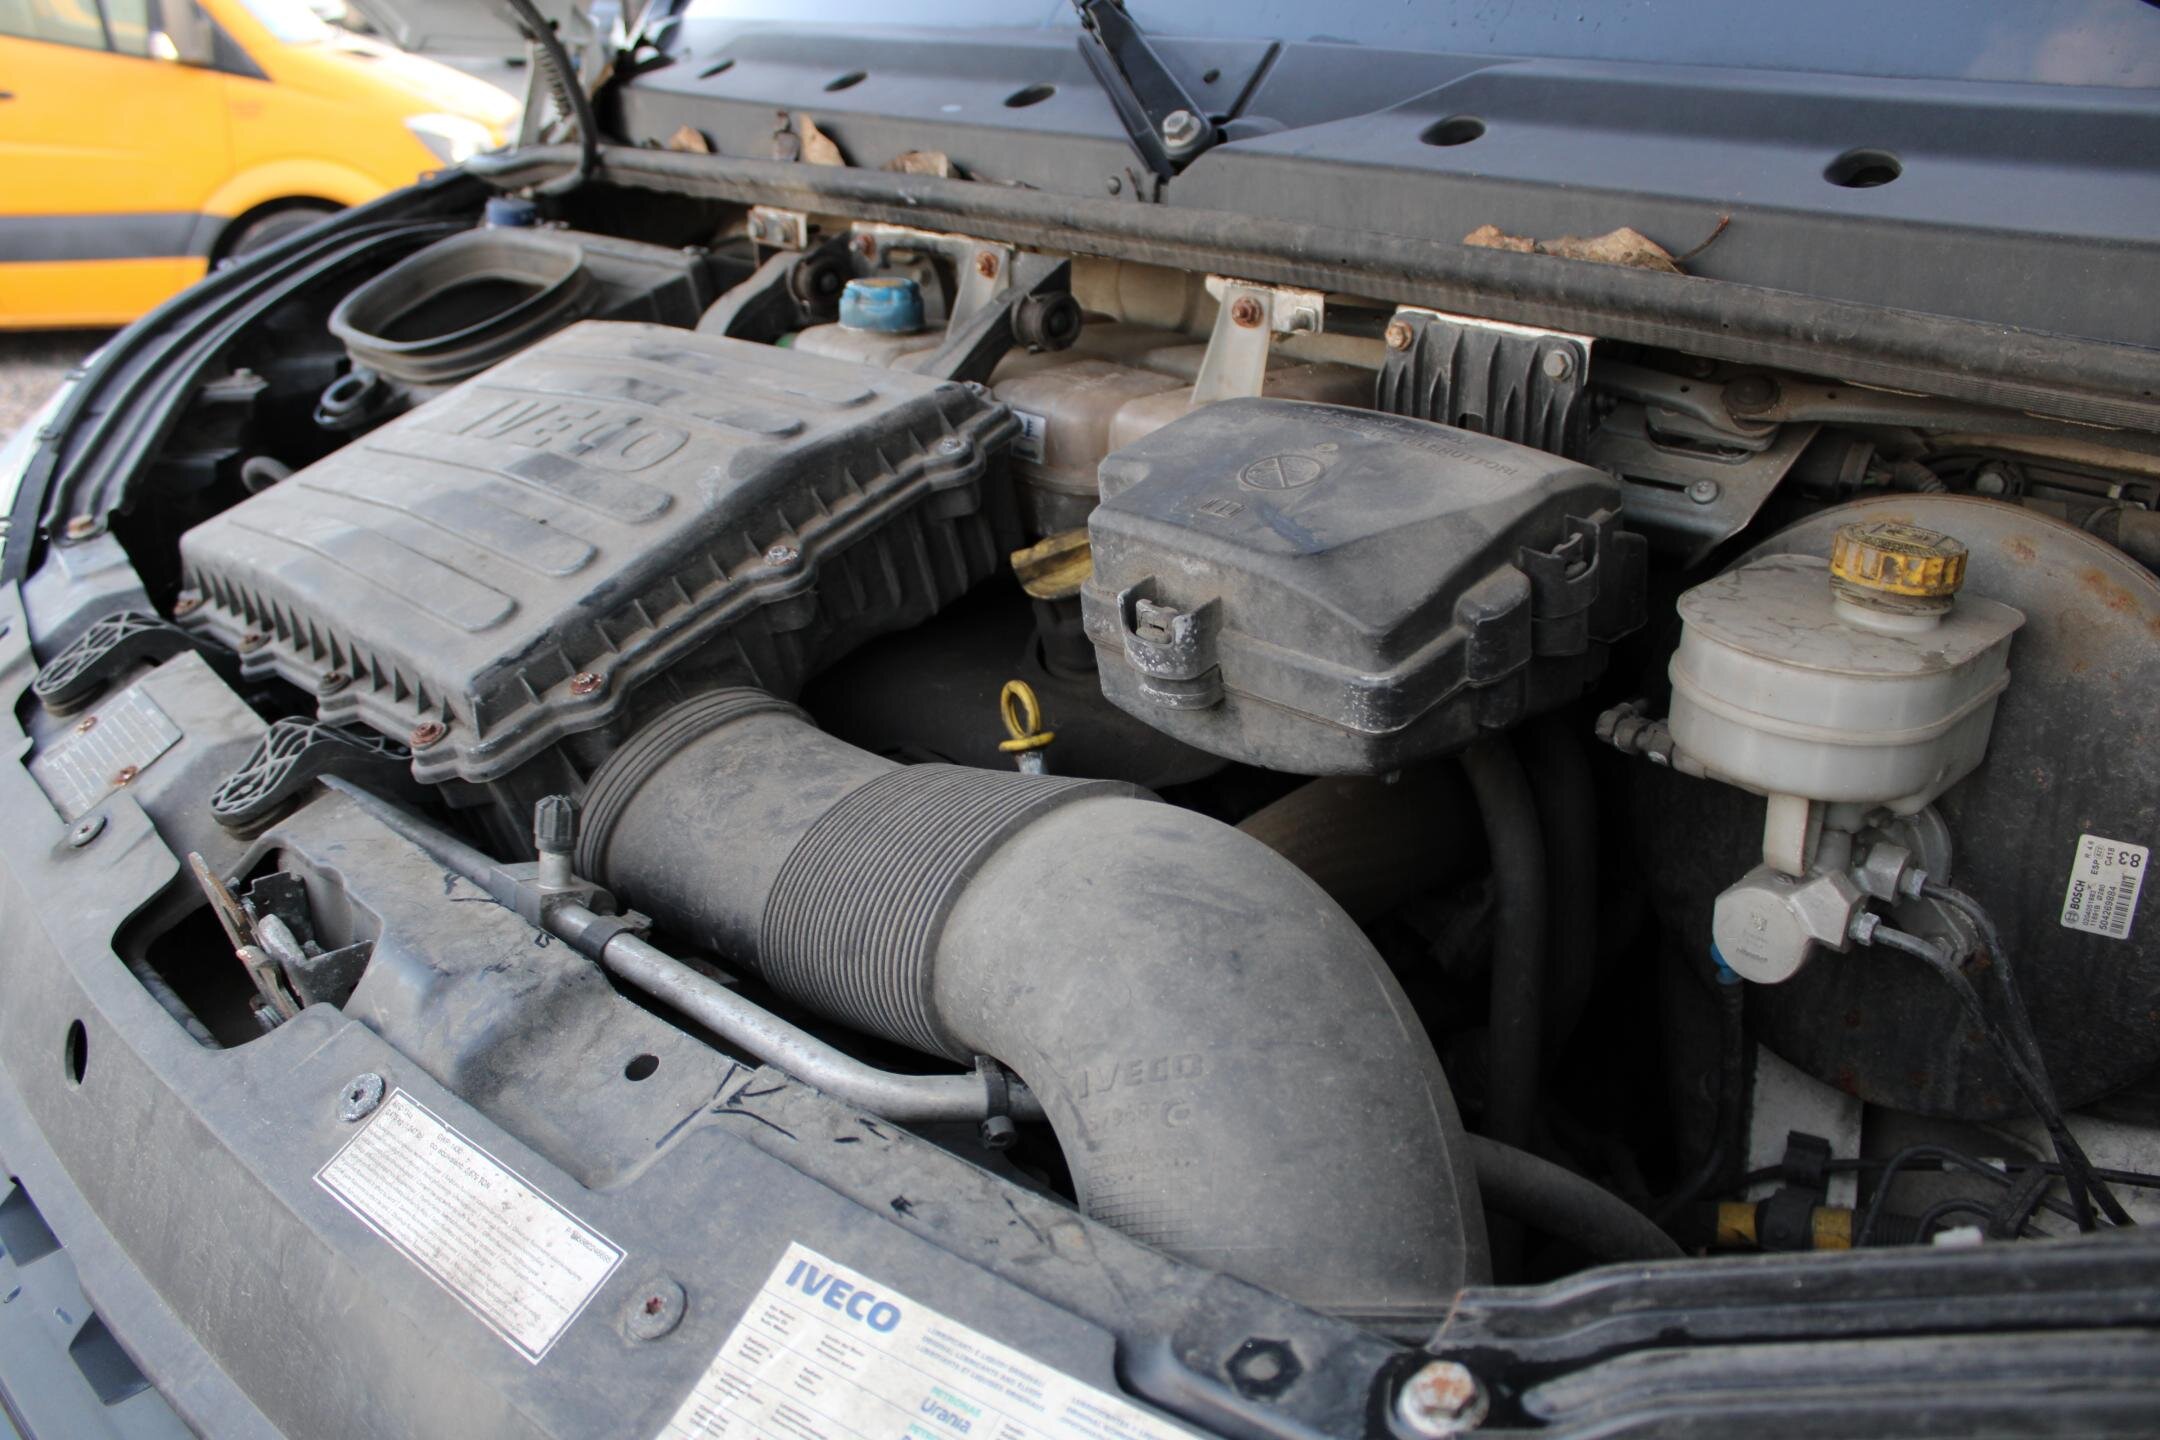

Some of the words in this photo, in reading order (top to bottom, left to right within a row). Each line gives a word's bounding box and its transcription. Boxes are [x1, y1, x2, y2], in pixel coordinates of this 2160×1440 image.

[449, 398, 692, 473] IVECO
[2091, 859, 2100, 875] ESP
[2070, 880, 2086, 910] BOSCH
[1078, 1052, 1204, 1100] IVECO
[785, 1259, 902, 1333] IVECO
[921, 1398, 972, 1434] Urania
